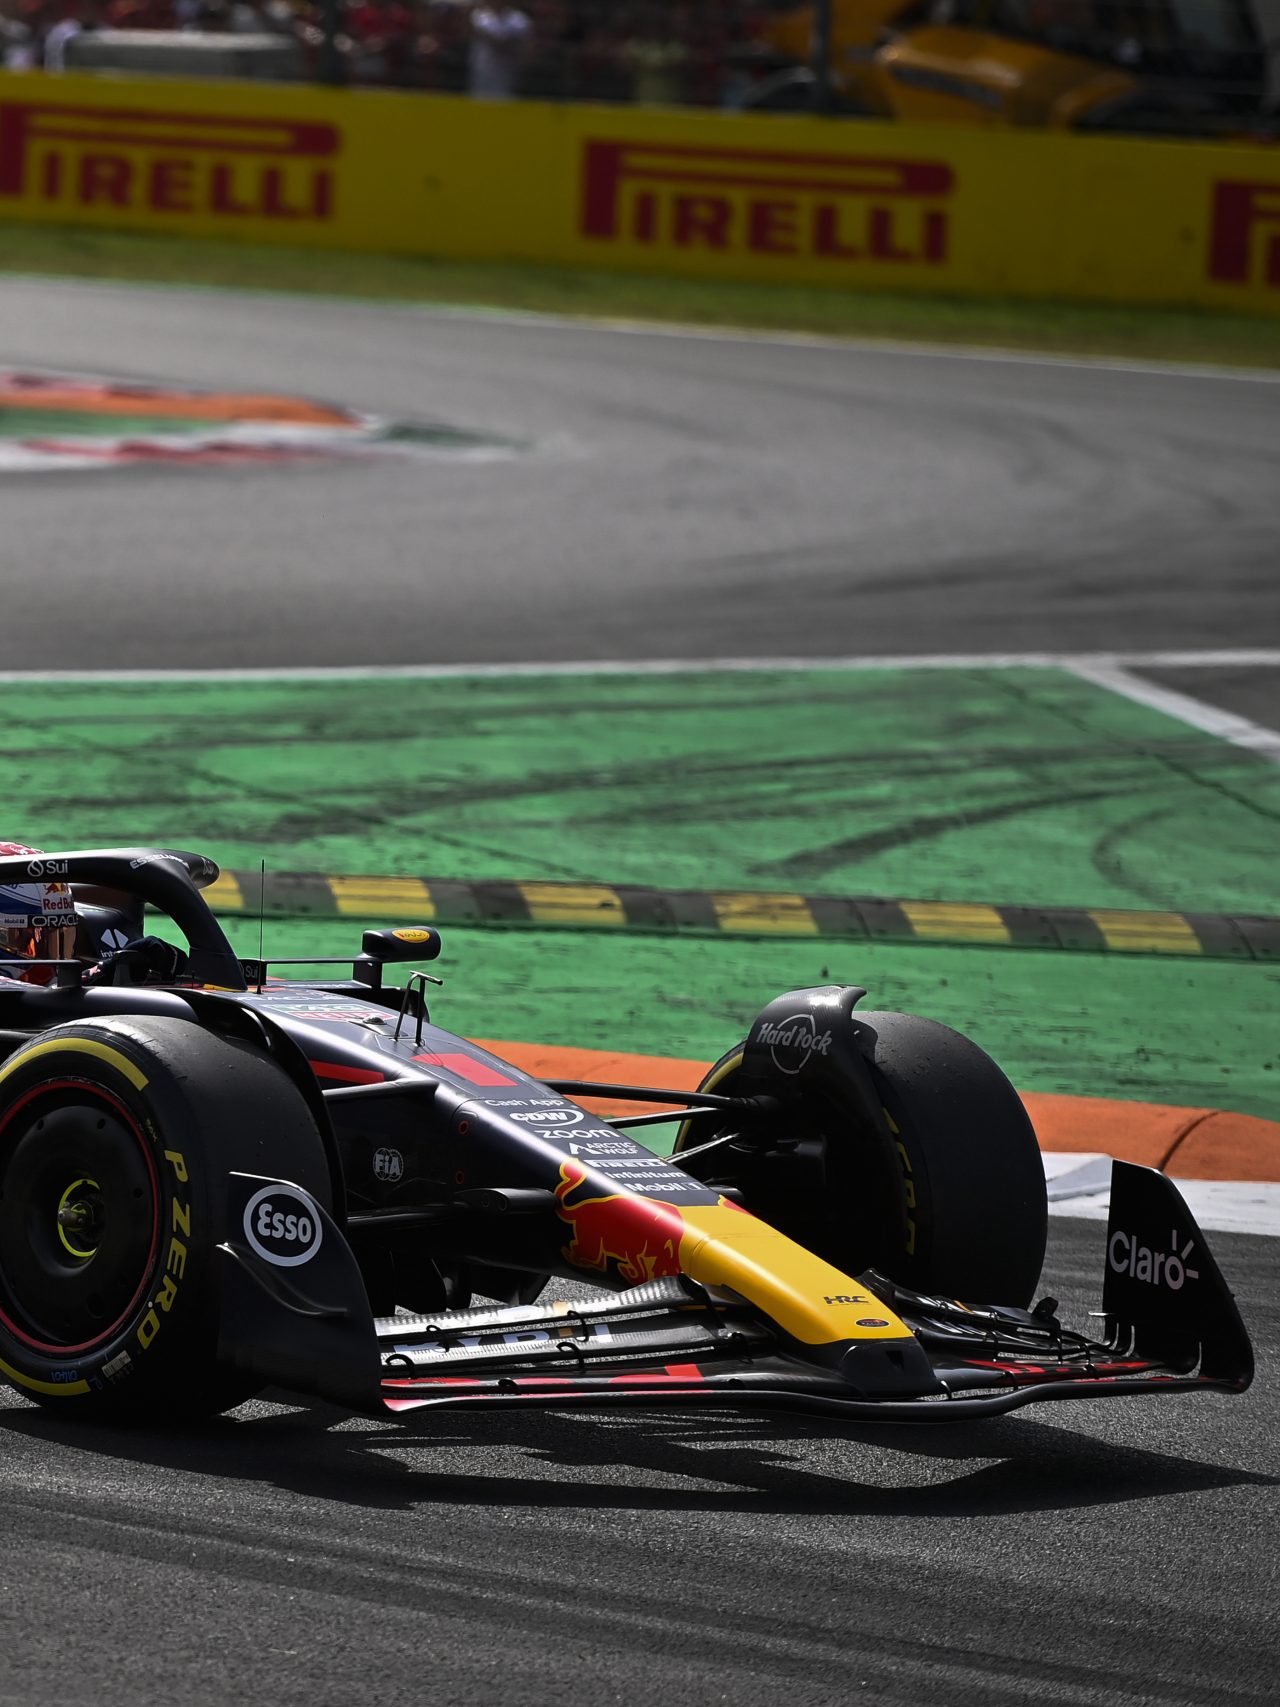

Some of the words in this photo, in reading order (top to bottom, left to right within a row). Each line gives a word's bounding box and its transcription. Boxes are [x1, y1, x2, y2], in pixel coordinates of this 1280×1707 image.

[580, 138, 956, 265] PIRELLI
[46, 860, 69, 874] Sui
[32, 915, 78, 927] ORACL
[756, 1023, 798, 1046] Hard
[794, 1027, 832, 1056] Rock
[534, 1129, 621, 1139] zoom
[164, 1150, 189, 1183] P
[624, 1183, 686, 1191] Mobil
[257, 1203, 312, 1244] Esso
[136, 1196, 191, 1350] ZERO
[1109, 1230, 1184, 1290] Claro
[824, 1296, 869, 1304] HRC
